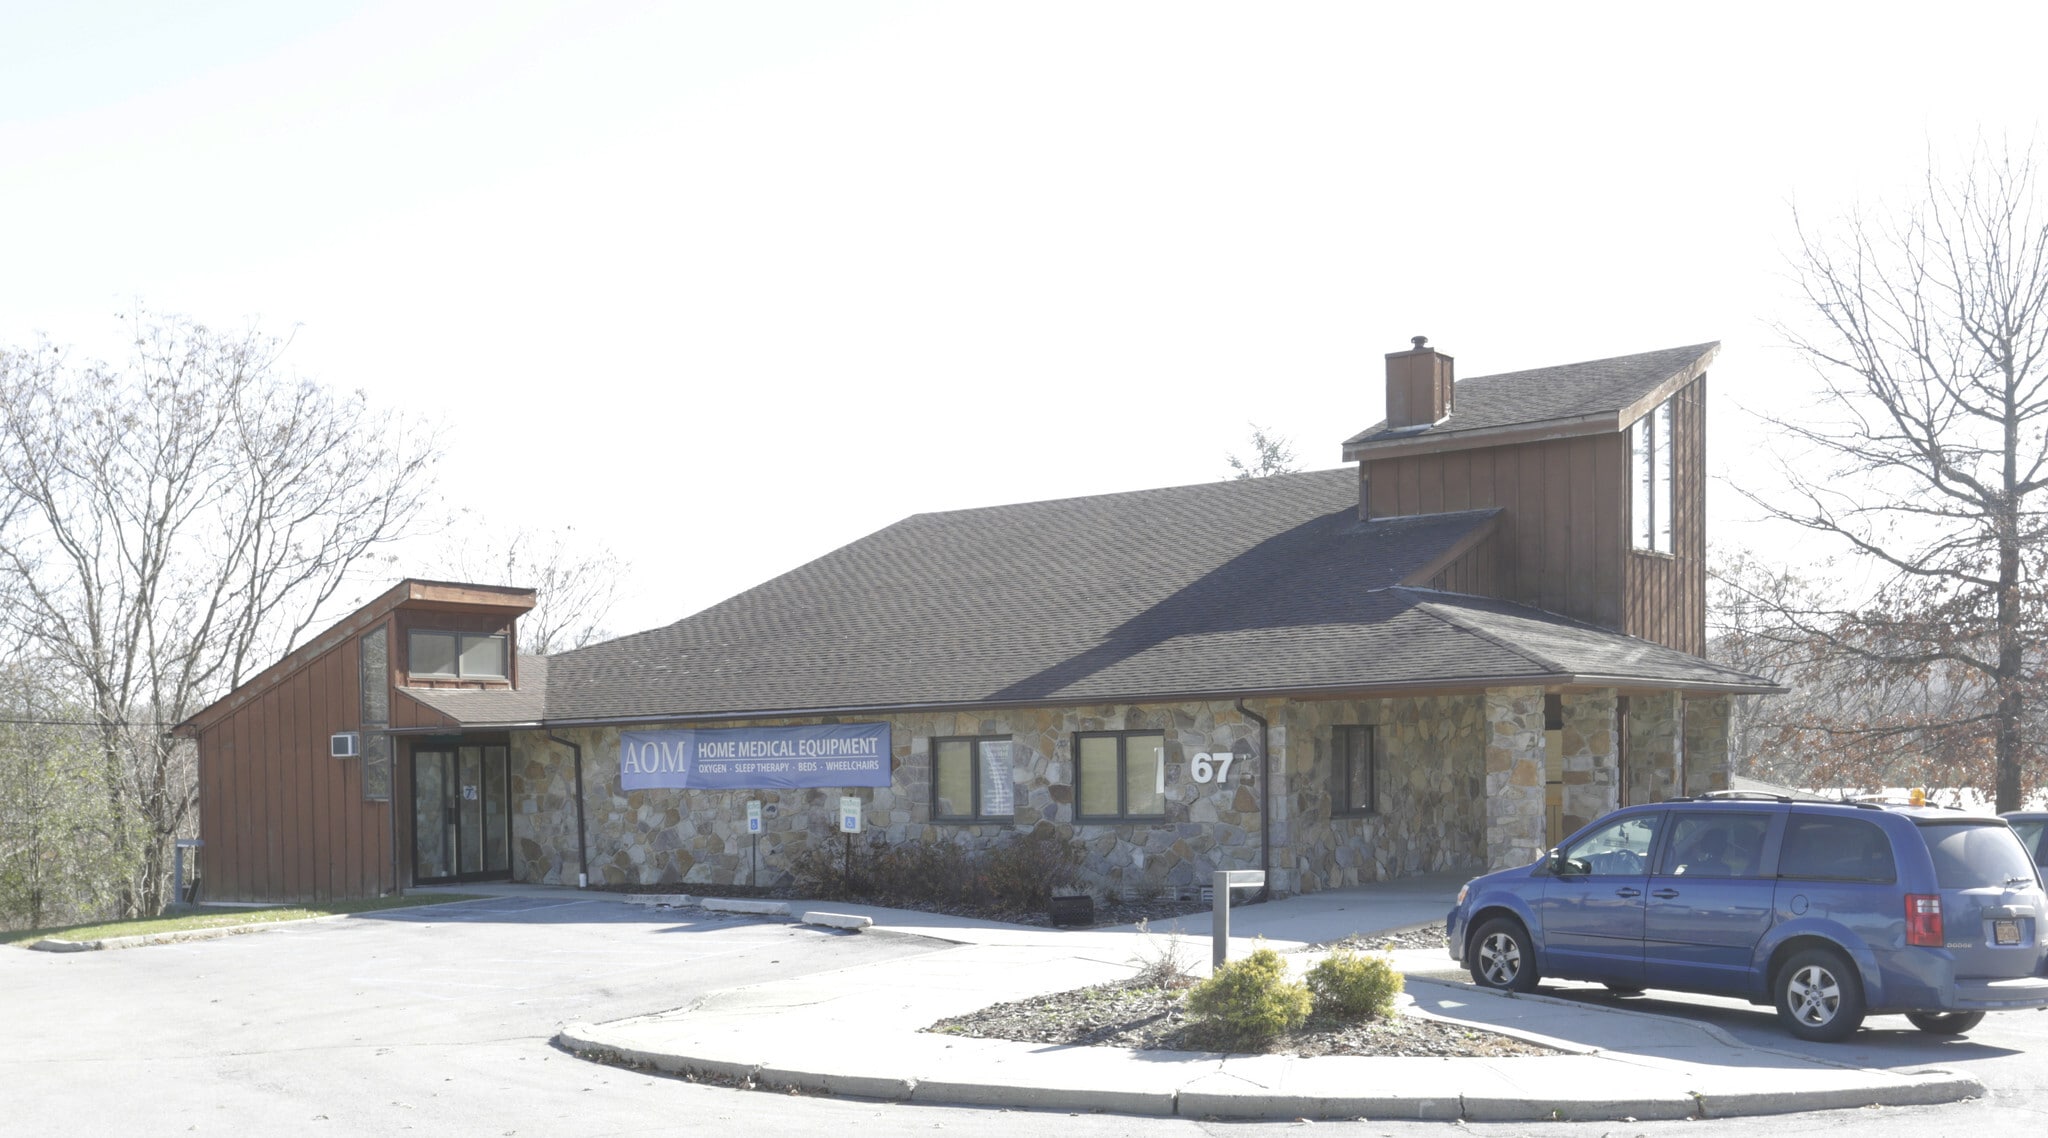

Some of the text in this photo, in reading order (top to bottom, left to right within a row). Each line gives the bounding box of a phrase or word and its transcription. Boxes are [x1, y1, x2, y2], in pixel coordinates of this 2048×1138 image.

[624, 741, 685, 773] AOM
[698, 738, 878, 757] HOME MEDICAL EQUIPMENT
[698, 760, 880, 773] OXYGEN SLEEP THERAPY BEDS WHEELCHAIRS
[1191, 752, 1234, 784] 67
